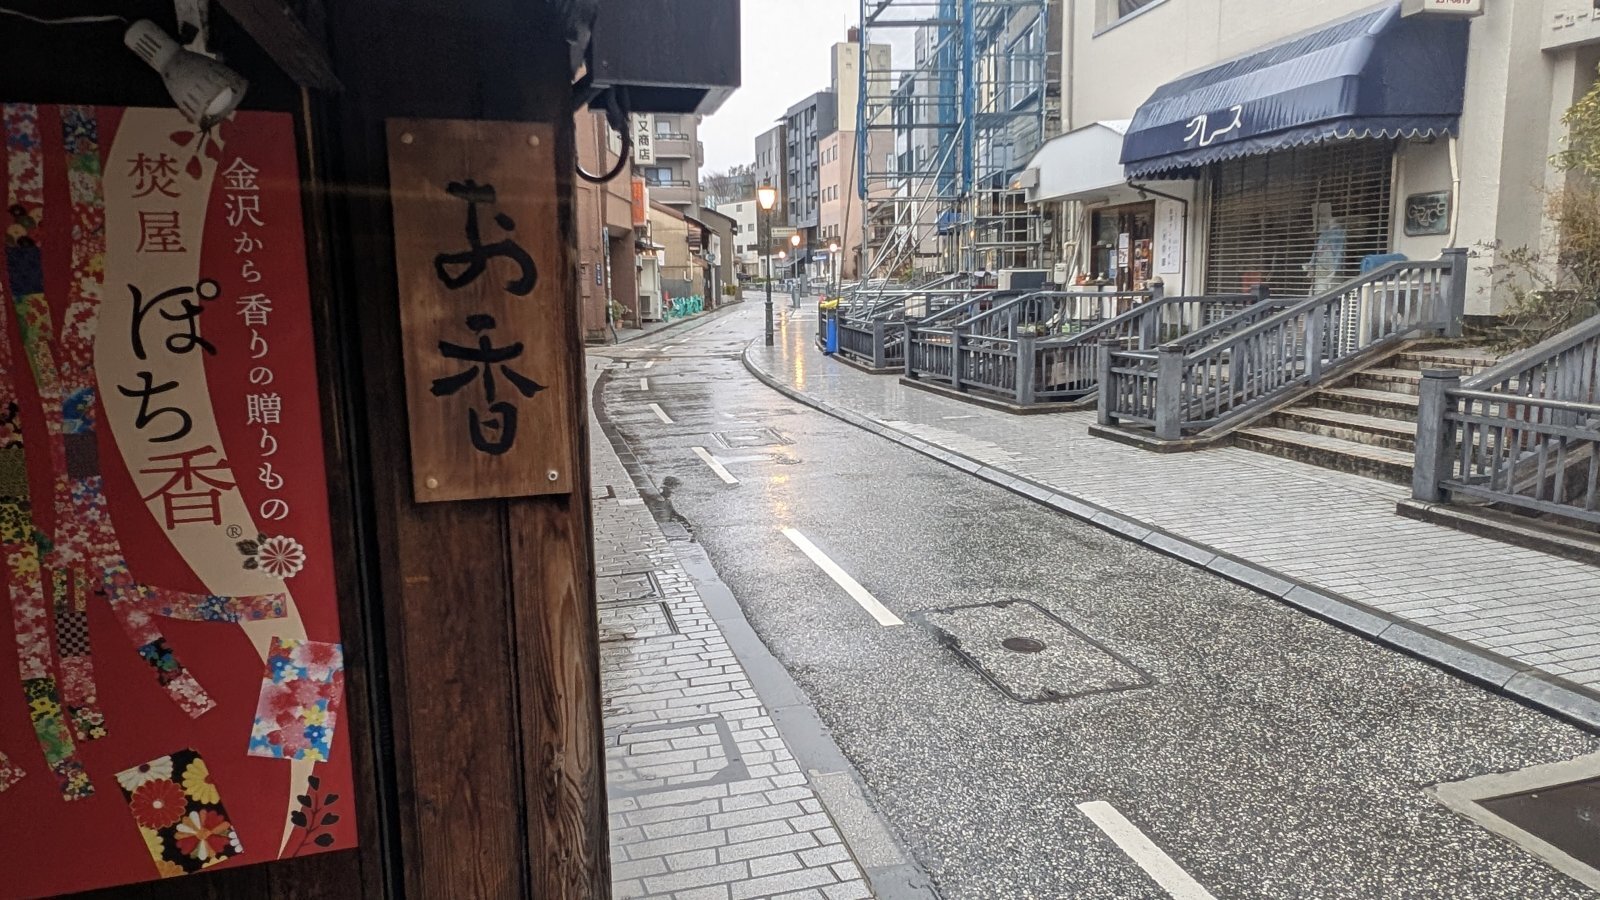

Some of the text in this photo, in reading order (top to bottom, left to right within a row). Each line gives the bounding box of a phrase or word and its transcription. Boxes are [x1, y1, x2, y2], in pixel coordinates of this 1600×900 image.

[116, 277, 238, 531] ぽち香
[221, 156, 290, 522] 金沢から香りの贈りもの
[430, 178, 550, 456] お香
